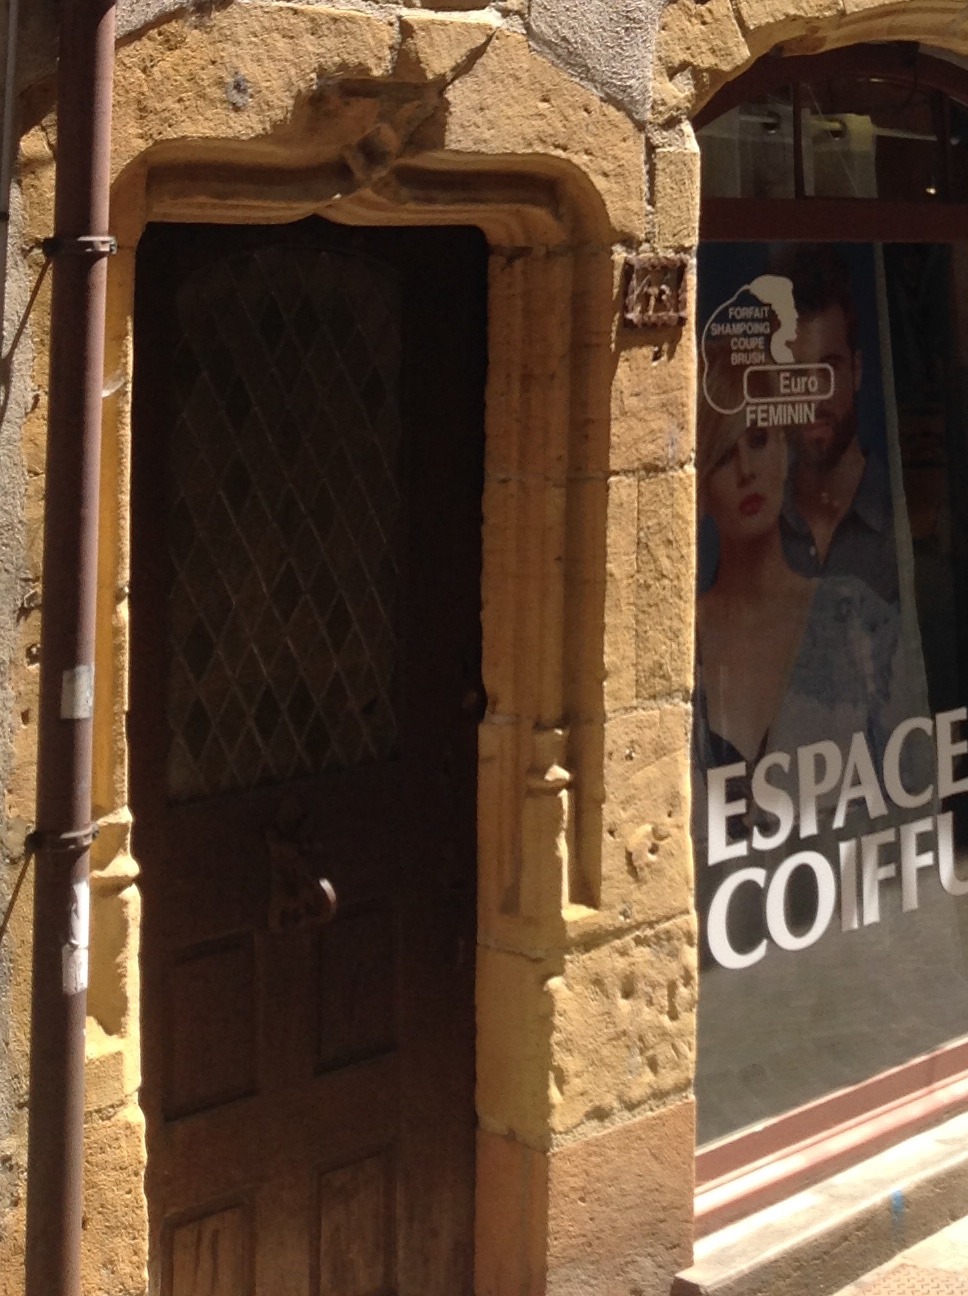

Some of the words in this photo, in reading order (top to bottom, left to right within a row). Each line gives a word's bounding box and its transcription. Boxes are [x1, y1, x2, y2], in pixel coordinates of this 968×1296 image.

[728, 306, 770, 319] FORFAIT
[711, 322, 770, 336] SHAMPOING
[731, 337, 765, 350] COUPE
[731, 352, 765, 365] BRUSH
[780, 372, 818, 394] Euro
[746, 403, 816, 428] FEMININ
